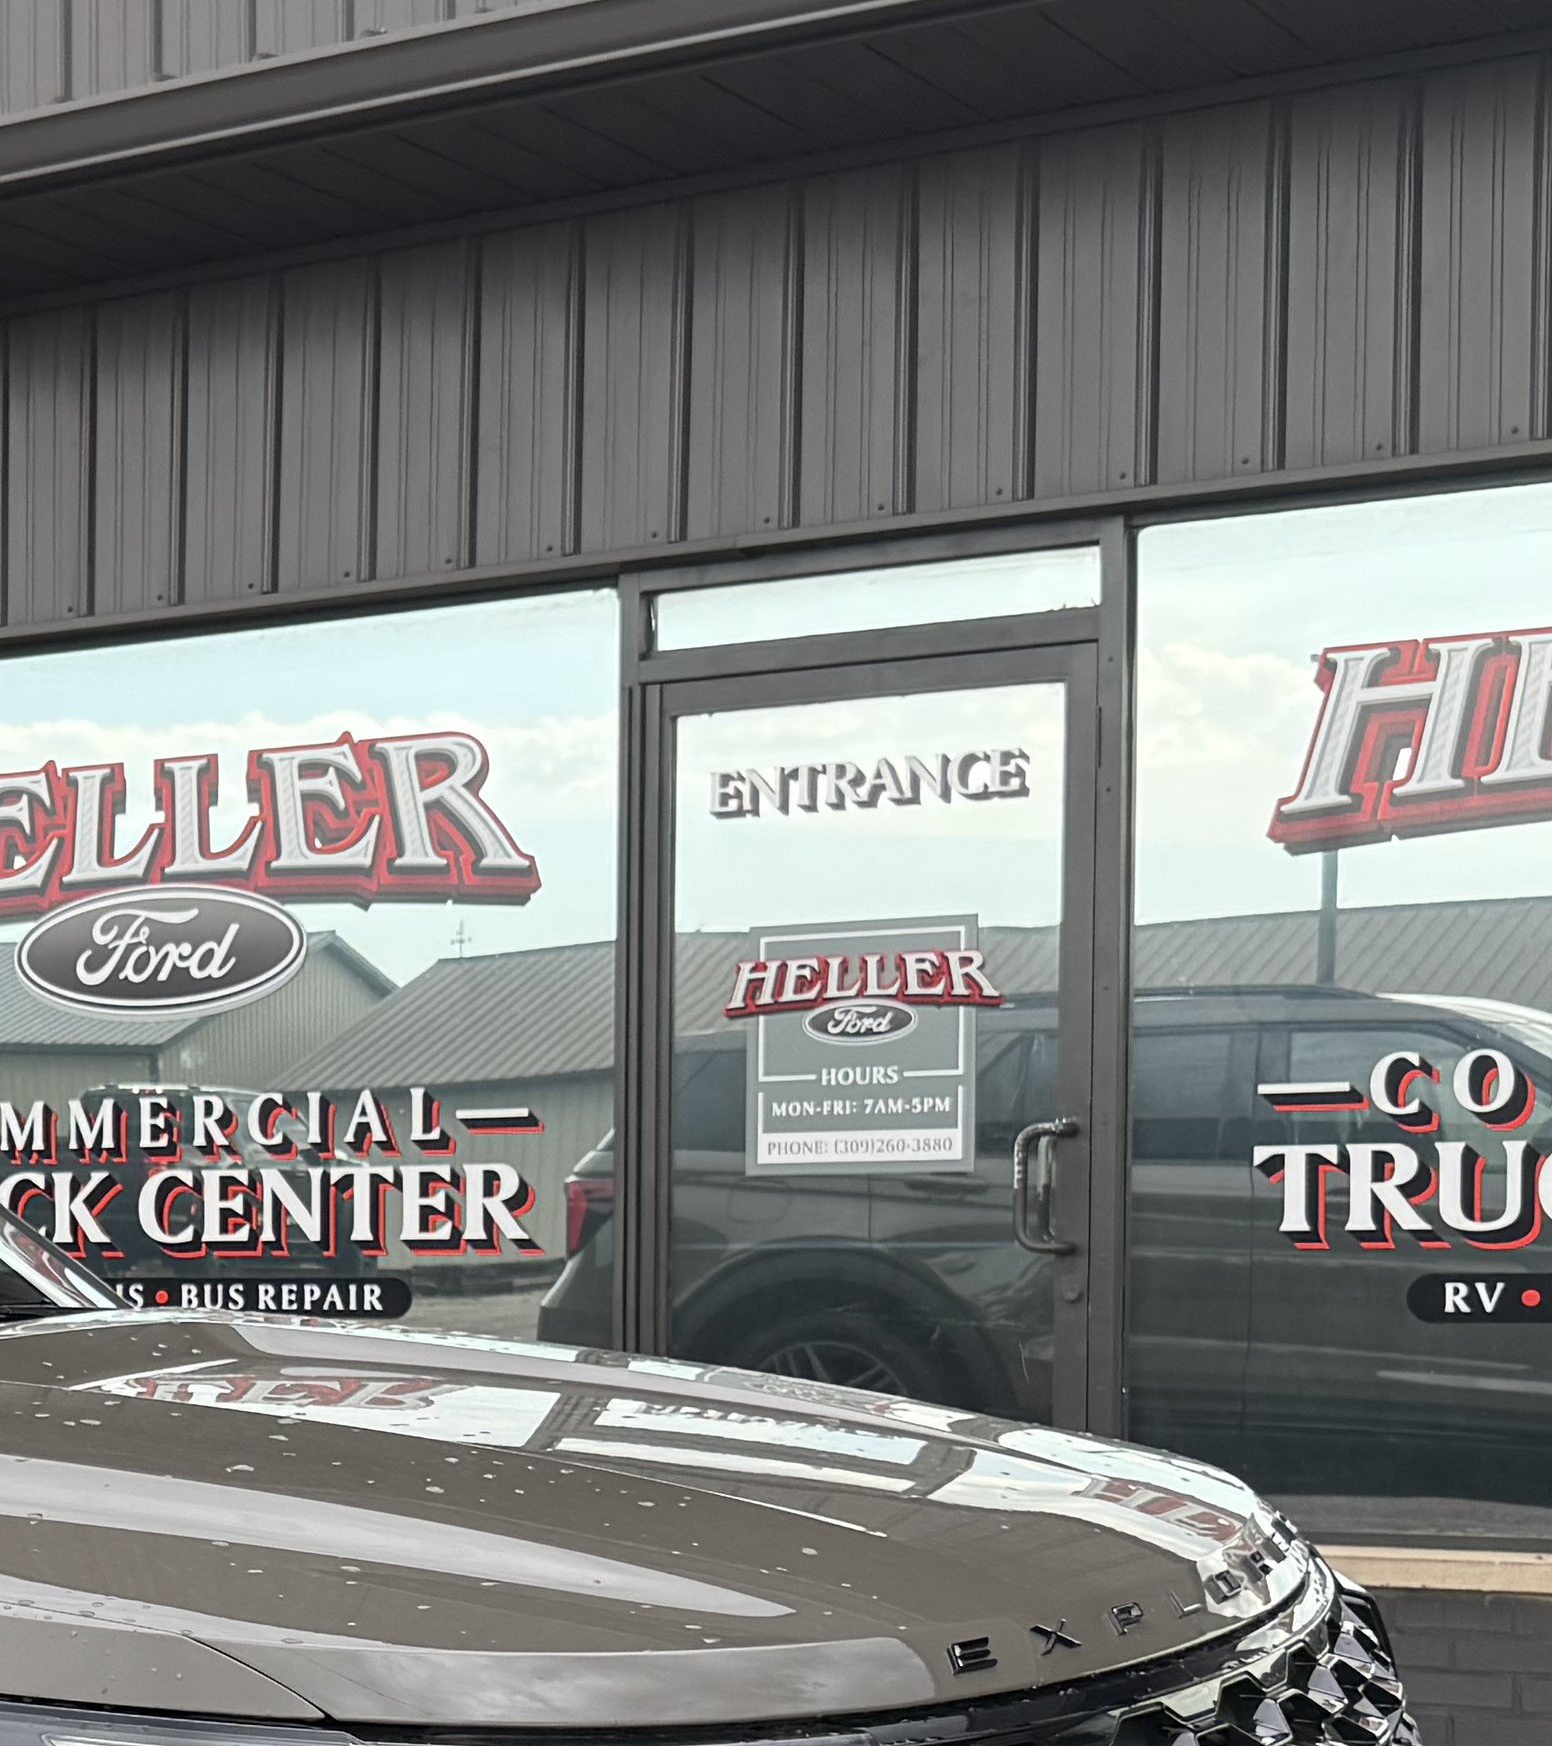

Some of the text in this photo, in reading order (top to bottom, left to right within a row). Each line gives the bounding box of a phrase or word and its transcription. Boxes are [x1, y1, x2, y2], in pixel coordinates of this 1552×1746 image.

[708, 748, 1030, 818] ENTRANCE
[74, 907, 239, 987] Ford
[725, 950, 1004, 1016] HELLER
[827, 1004, 894, 1035] Ford
[820, 1065, 900, 1087] HOURS
[770, 1096, 952, 1118] MON-FRI: 7AM-5PM
[767, 1135, 954, 1157] PHONE: (309)260-3880
[138, 1162, 535, 1250] CENTER
[180, 1283, 245, 1311] BUS
[258, 1283, 384, 1312] REPAIR
[1444, 1281, 1506, 1313] RV
